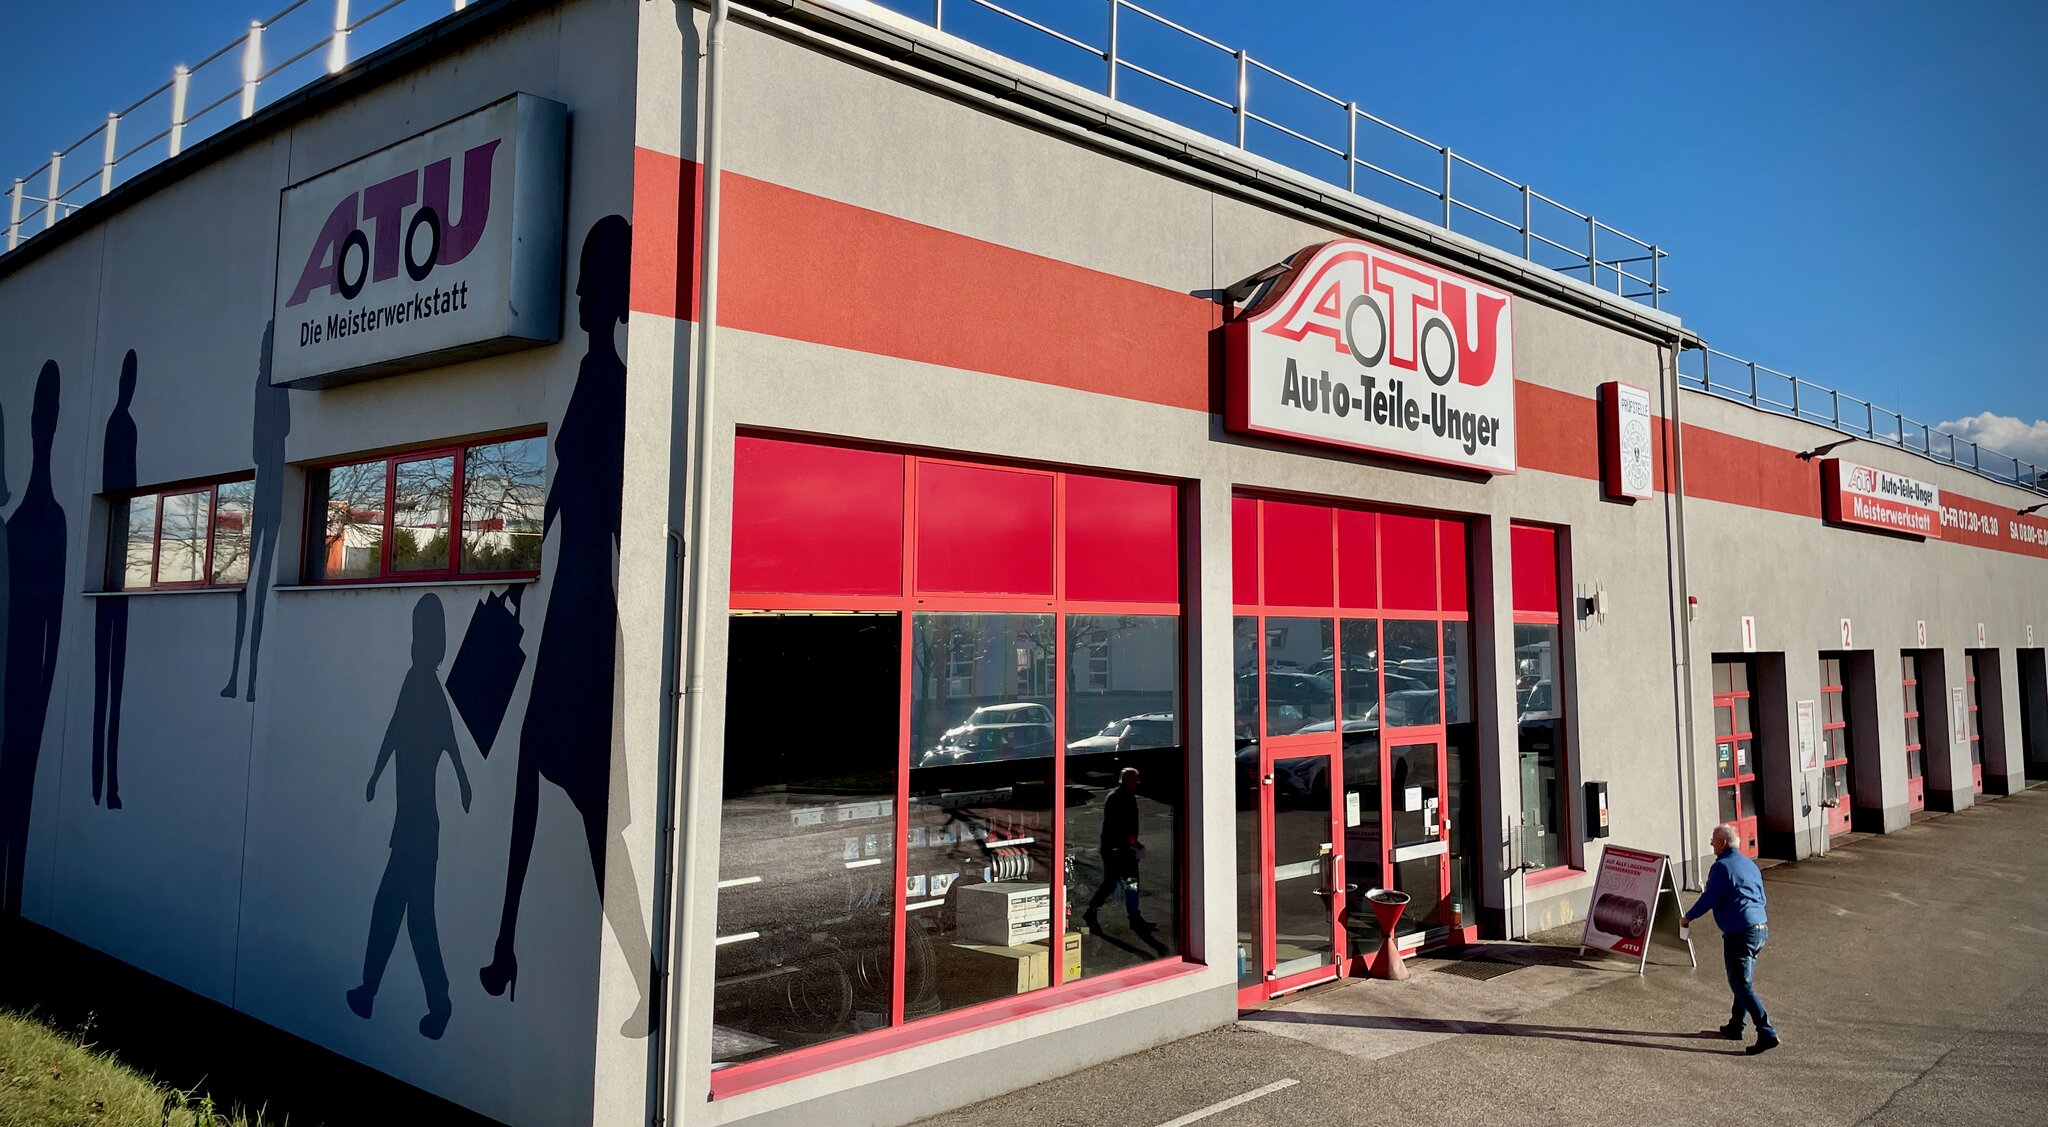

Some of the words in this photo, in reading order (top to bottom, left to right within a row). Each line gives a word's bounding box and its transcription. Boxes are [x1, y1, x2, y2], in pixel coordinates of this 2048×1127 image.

[300, 318, 322, 348] Die
[326, 280, 468, 341] Meisterwerkstatt
[1281, 357, 1499, 455] Auto-Teile-Unger
[1621, 397, 1649, 418] PRÜFSTELLE
[1881, 474, 1933, 507] Auto-Teile-Unger
[1853, 496, 1931, 531] Meisterwerkstatt
[2009, 521, 2019, 540] SA
[1746, 619, 1752, 649] 1
[1843, 621, 1851, 647] 2
[1919, 623, 1925, 646] 3
[1979, 625, 1984, 645] 4
[2027, 627, 2033, 646] 5
[1615, 860, 1627, 868] ALLE
[1621, 943, 1640, 952] ATU
